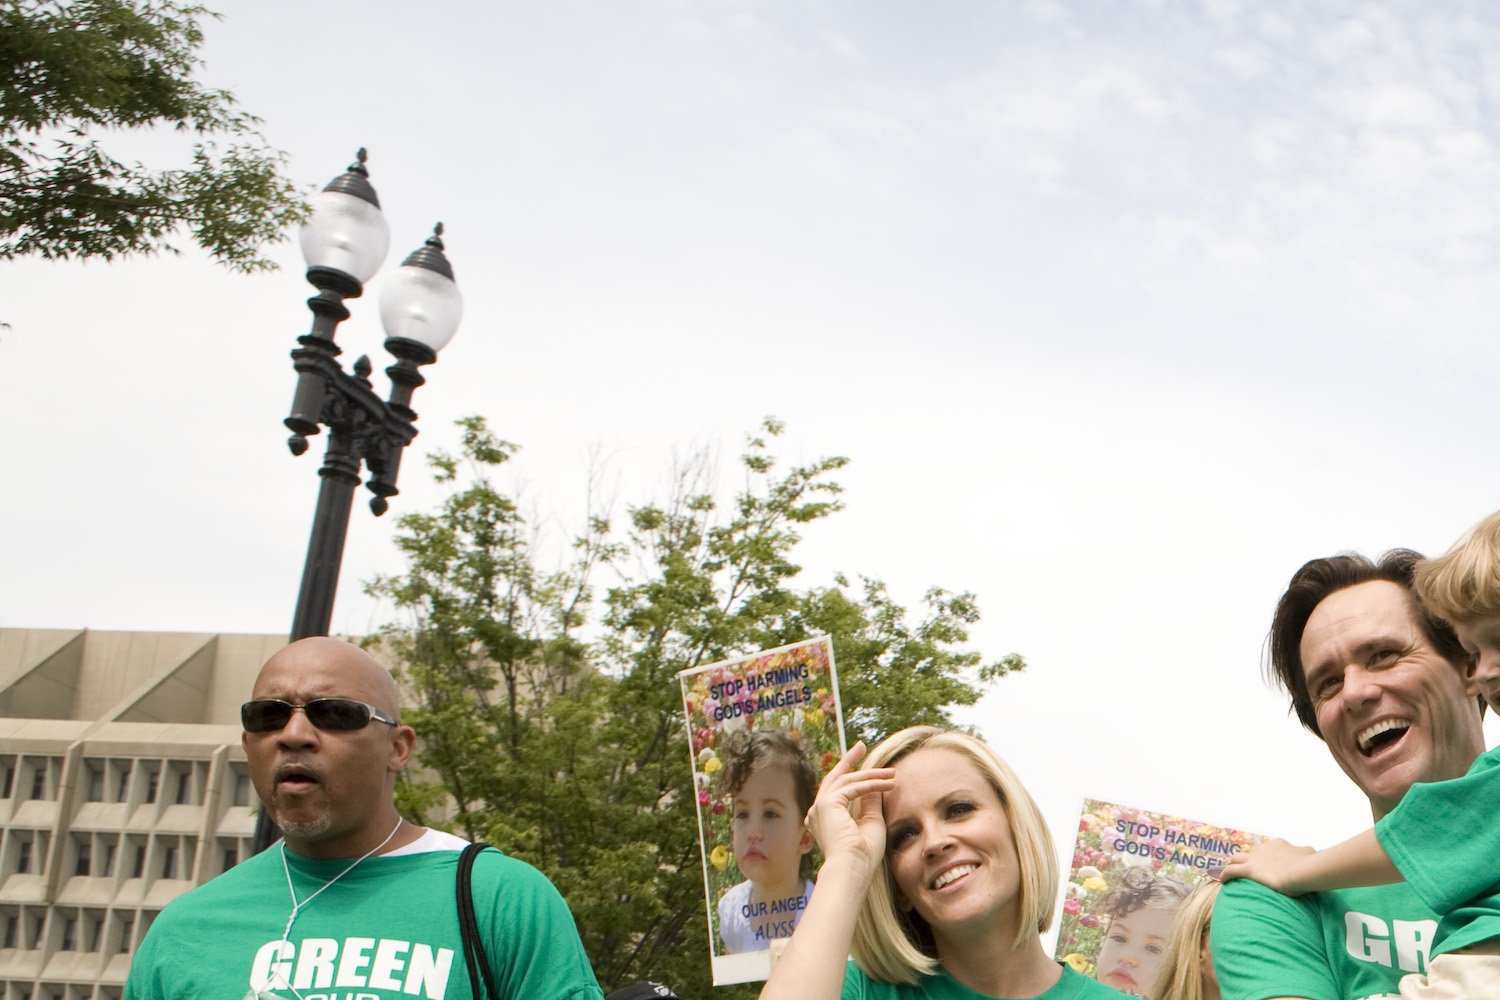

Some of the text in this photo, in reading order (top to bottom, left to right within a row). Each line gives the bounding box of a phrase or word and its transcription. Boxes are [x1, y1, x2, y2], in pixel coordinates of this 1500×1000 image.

[710, 663, 809, 700] STOP HARMING
[714, 686, 812, 721] GOD'S ANGELS
[1116, 819, 1160, 838] STOP
[1113, 839, 1167, 860] GOD'S
[742, 902, 768, 918] OUR
